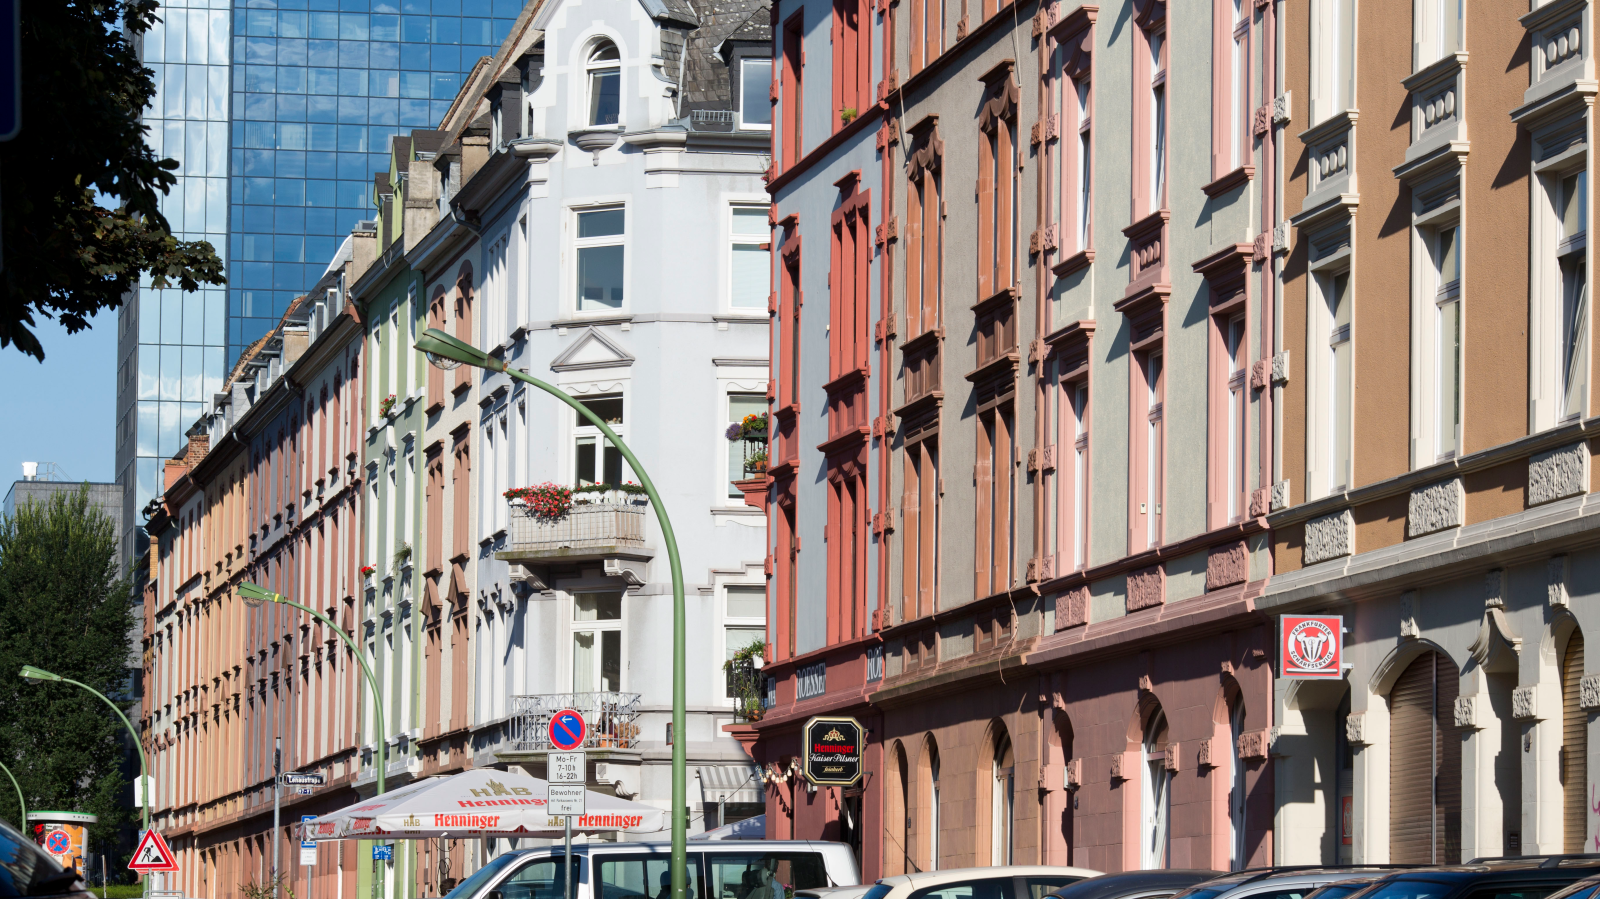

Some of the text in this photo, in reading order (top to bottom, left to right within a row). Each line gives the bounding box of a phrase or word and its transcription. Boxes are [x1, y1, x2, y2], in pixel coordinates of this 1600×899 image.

[1291, 621, 1332, 636] FRANKFURTER
[1291, 650, 1333, 669] SCHARFSERVICE
[814, 743, 854, 755] Henninger
[556, 755, 577, 763] Mo-Fr
[809, 753, 860, 763] Kaiser Pilsner
[556, 772, 578, 780] 16-22h
[434, 813, 500, 829] Henninger
[578, 813, 643, 829] Henninger
